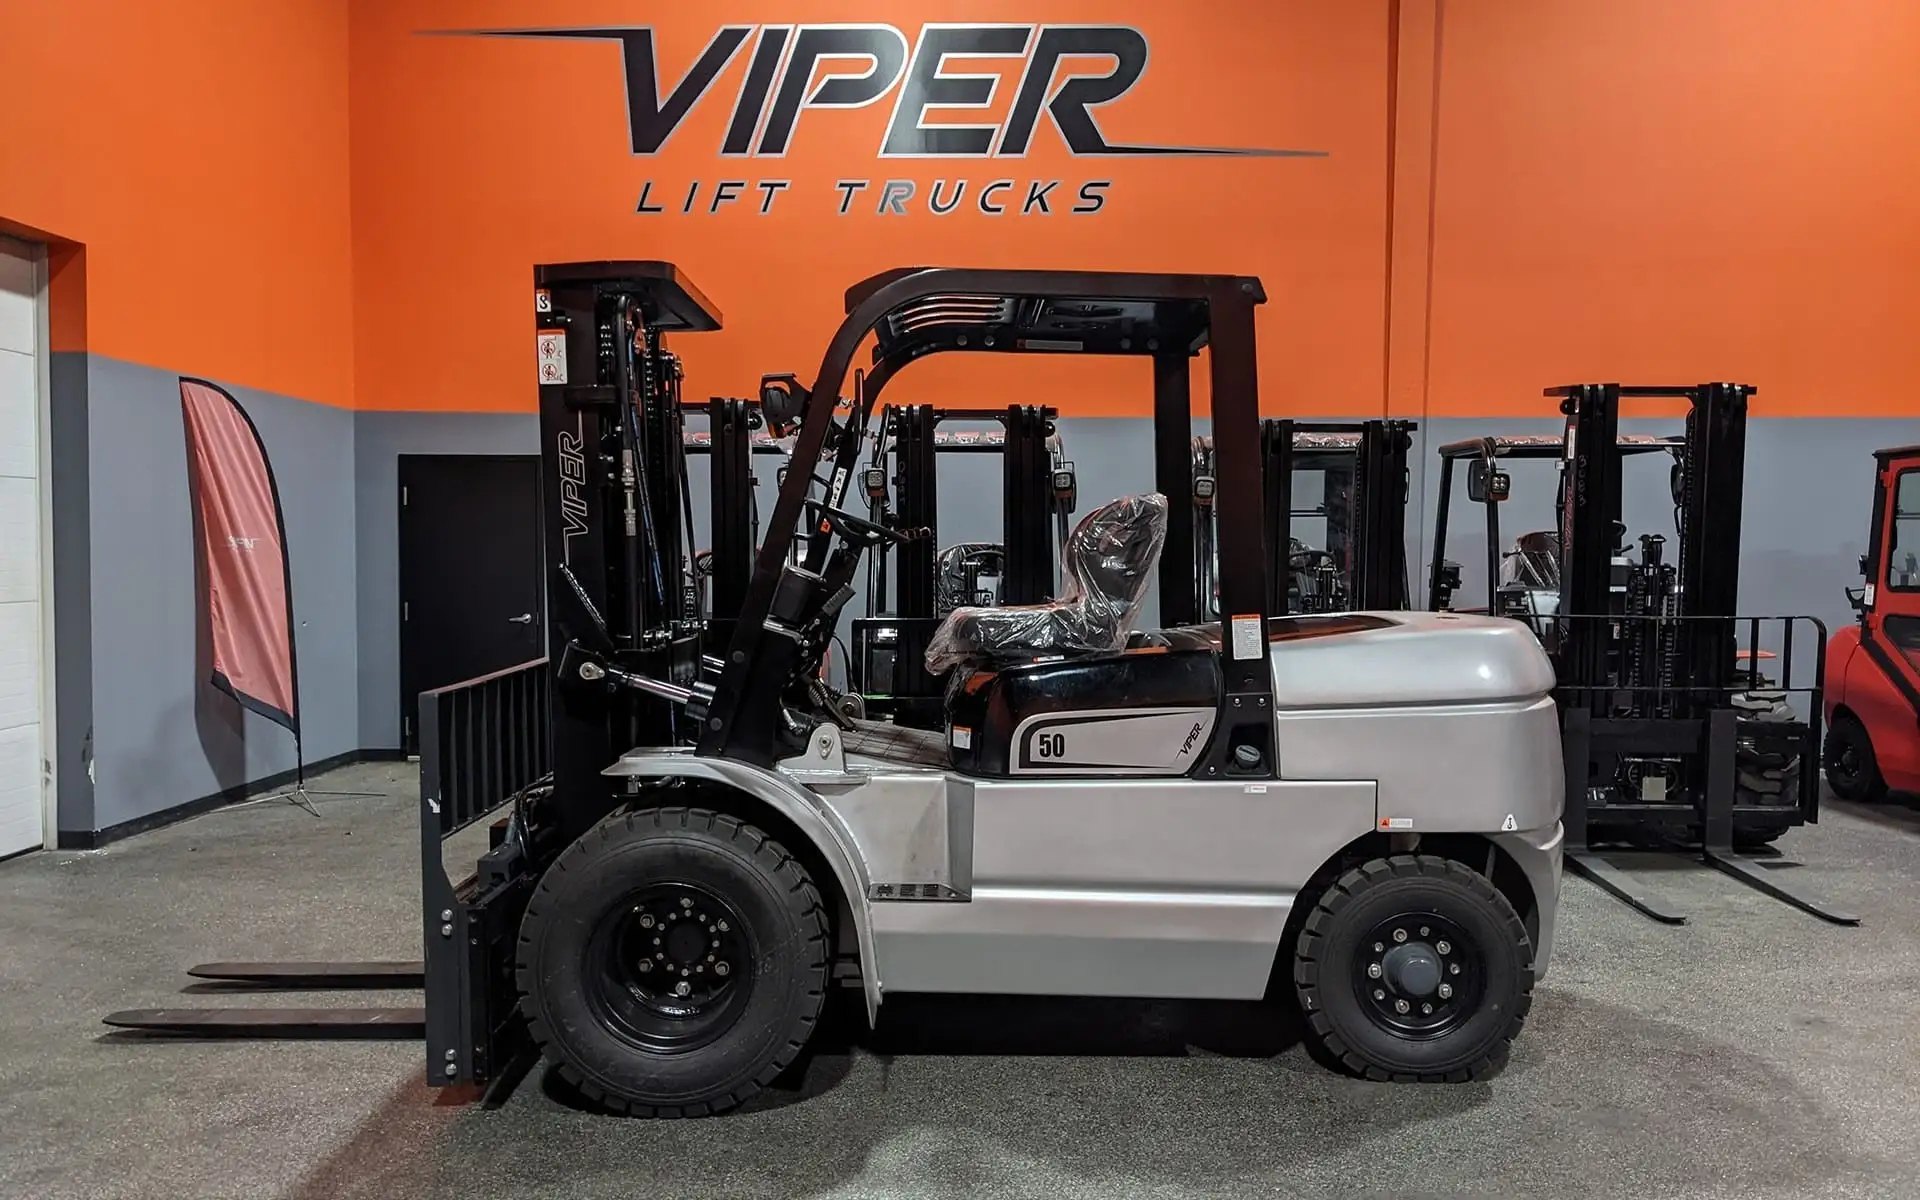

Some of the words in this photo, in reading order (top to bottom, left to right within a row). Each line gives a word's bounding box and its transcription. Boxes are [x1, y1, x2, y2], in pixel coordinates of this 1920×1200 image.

[616, 22, 1150, 160] VIPER
[635, 180, 790, 214] LIFT
[835, 180, 1112, 216] TRUCKS
[557, 430, 589, 535] VIPER
[1039, 733, 1065, 758] 50
[1178, 721, 1204, 756] VIPER
